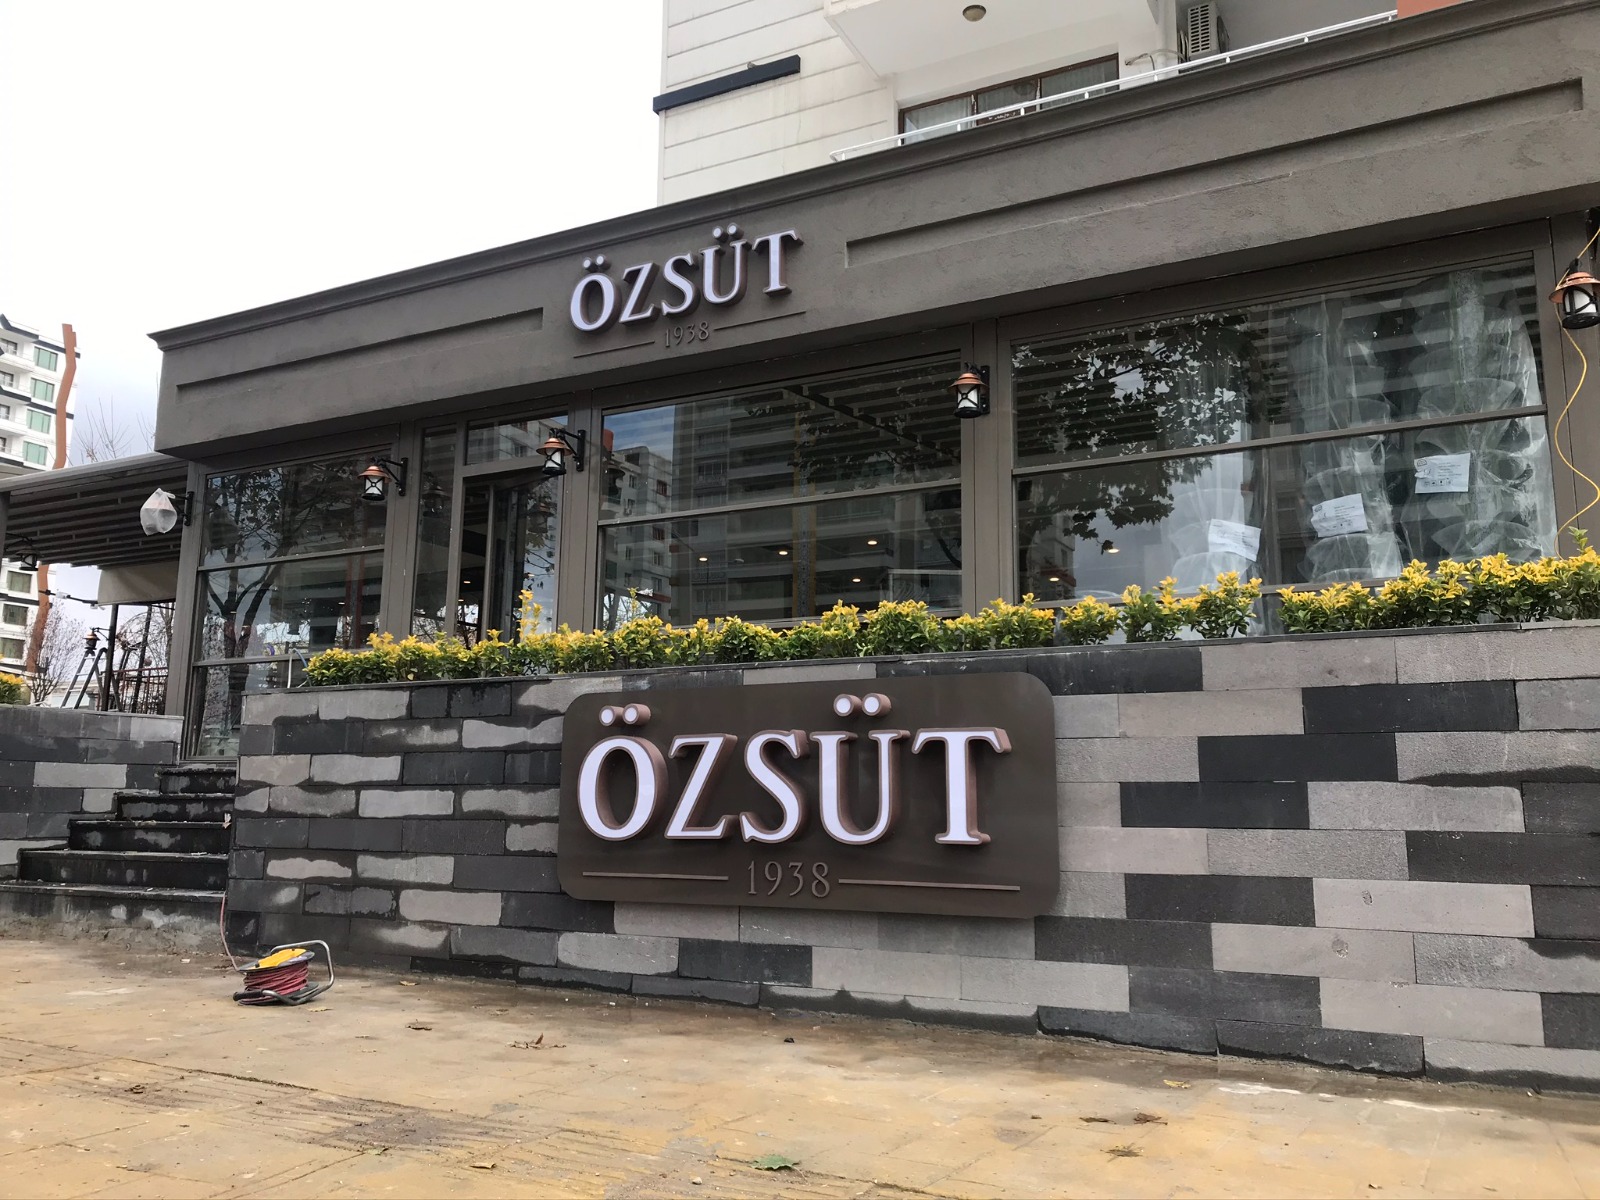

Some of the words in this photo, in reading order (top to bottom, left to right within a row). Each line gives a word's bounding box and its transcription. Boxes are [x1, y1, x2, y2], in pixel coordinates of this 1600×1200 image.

[569, 223, 804, 334] ÖZSÜT
[663, 320, 710, 348] 1938
[577, 692, 1012, 846] ÖZSÜT
[746, 860, 832, 898] 1938
